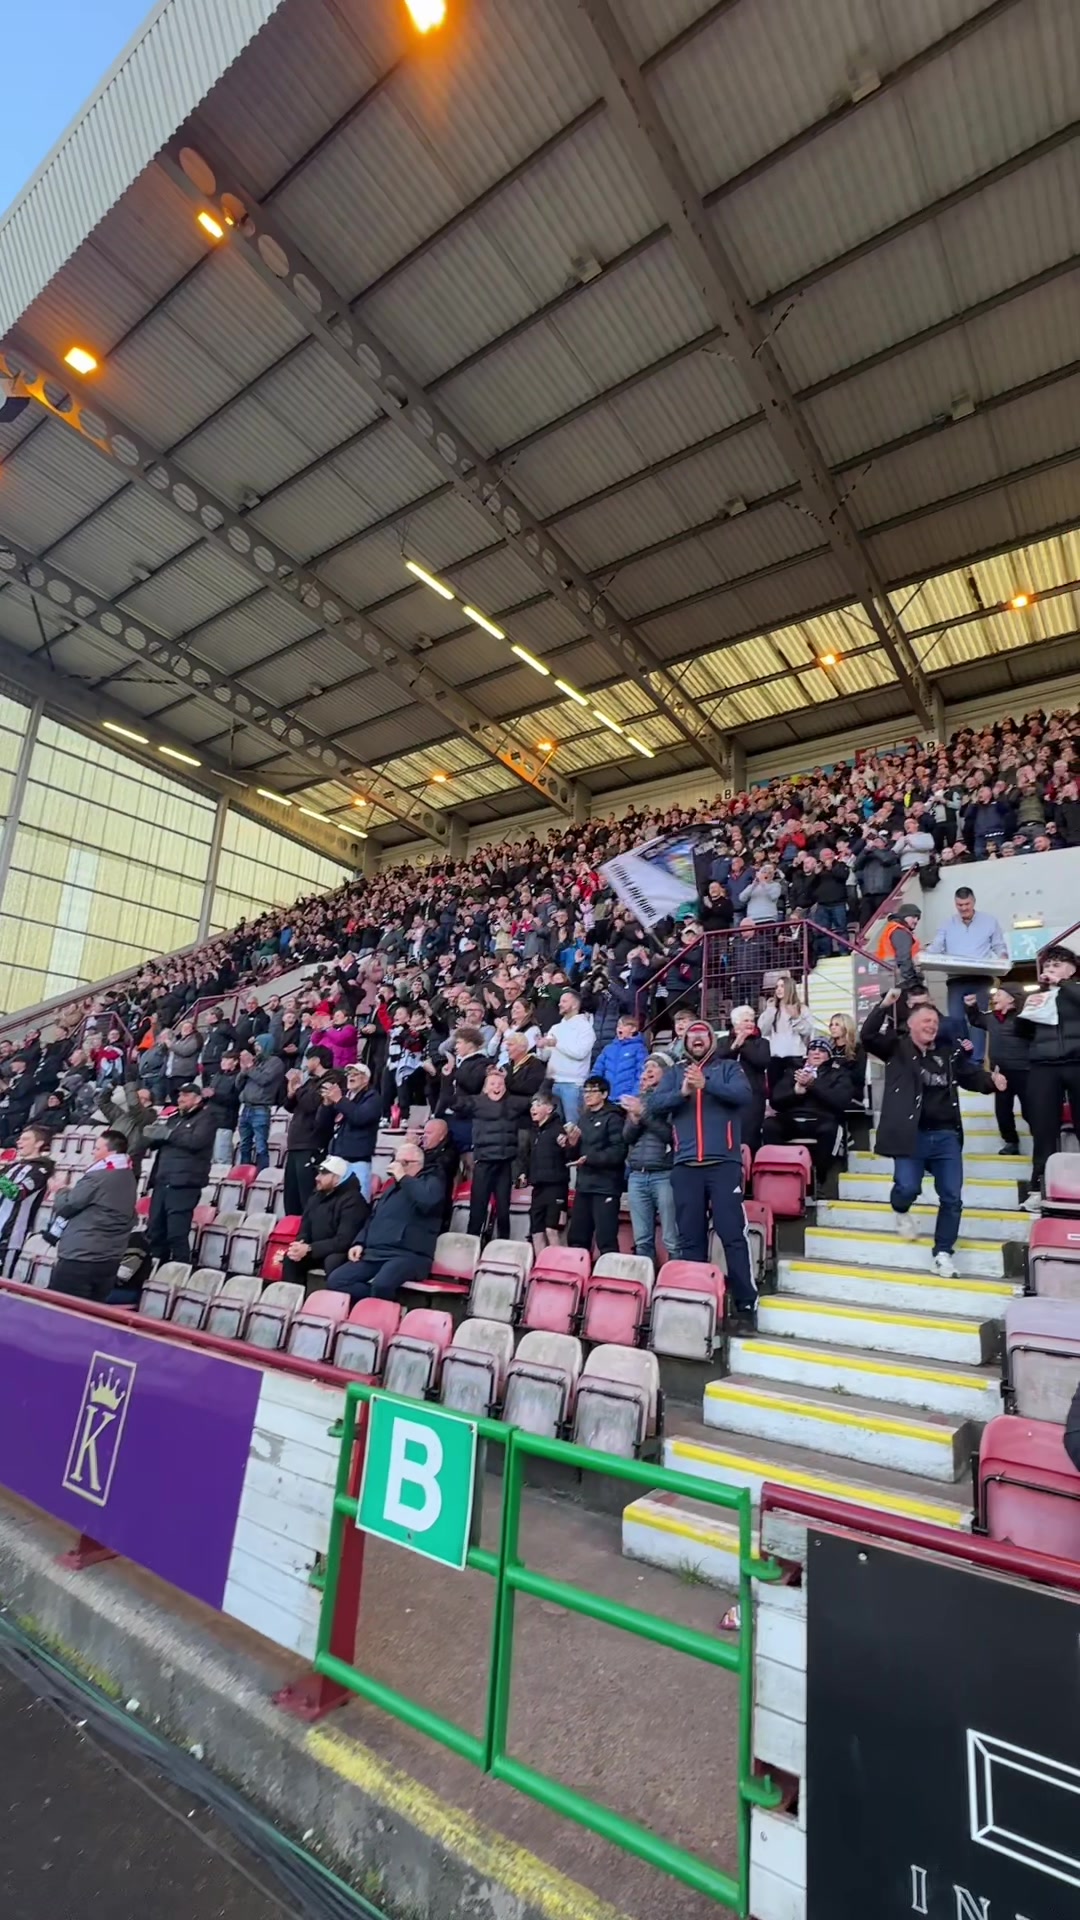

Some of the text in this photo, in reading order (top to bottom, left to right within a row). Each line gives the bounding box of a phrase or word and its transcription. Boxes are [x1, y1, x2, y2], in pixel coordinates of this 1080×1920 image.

[926, 741, 936, 754] B
[724, 788, 732, 800] B
[70, 1404, 117, 1491] K
[383, 1416, 443, 1532] B
[911, 1865, 1031, 1920] IN
